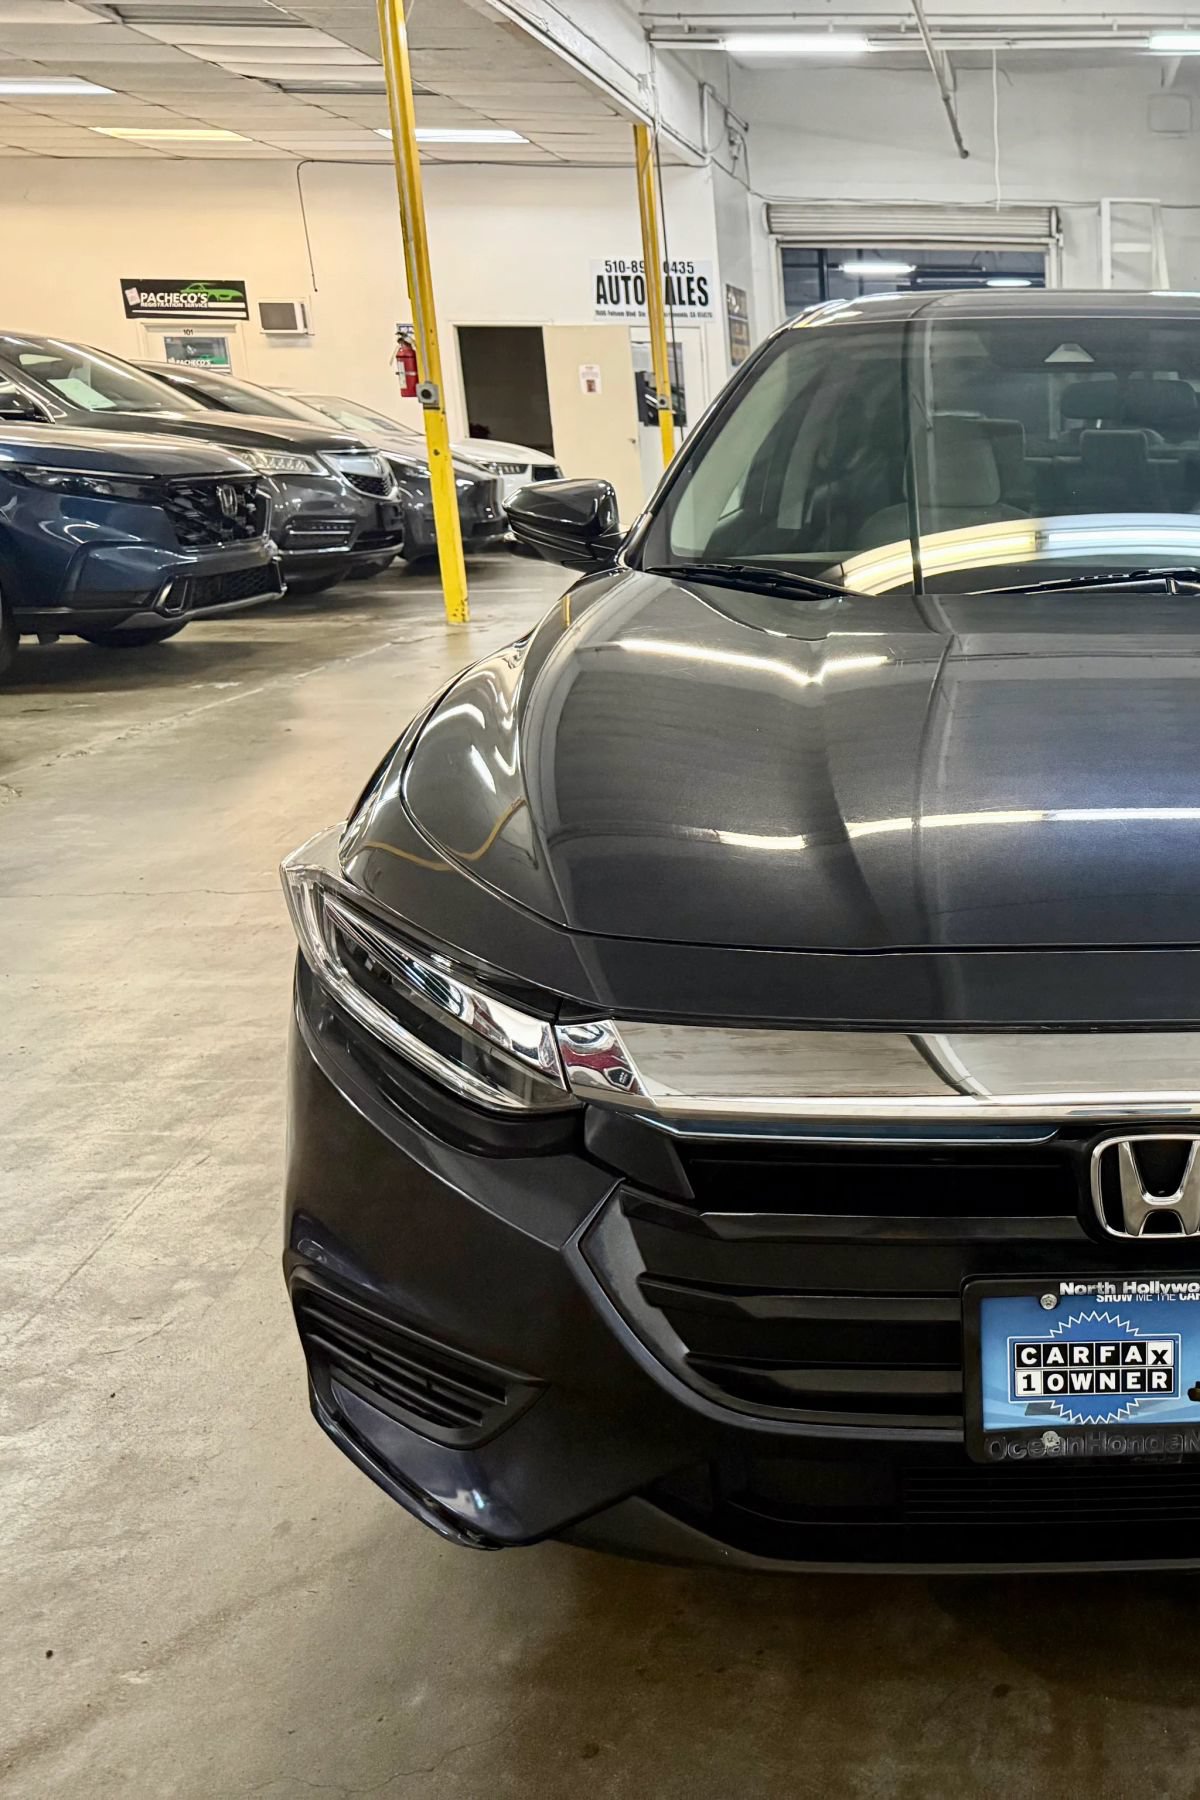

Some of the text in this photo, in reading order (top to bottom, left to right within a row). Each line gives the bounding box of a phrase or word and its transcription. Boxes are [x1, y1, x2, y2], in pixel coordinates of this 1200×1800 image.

[140, 292, 208, 303] PACHECO'S
[596, 275, 710, 307] AUTO ALES
[1060, 1282, 1115, 1296] North
[1020, 1345, 1169, 1366] CARFAX
